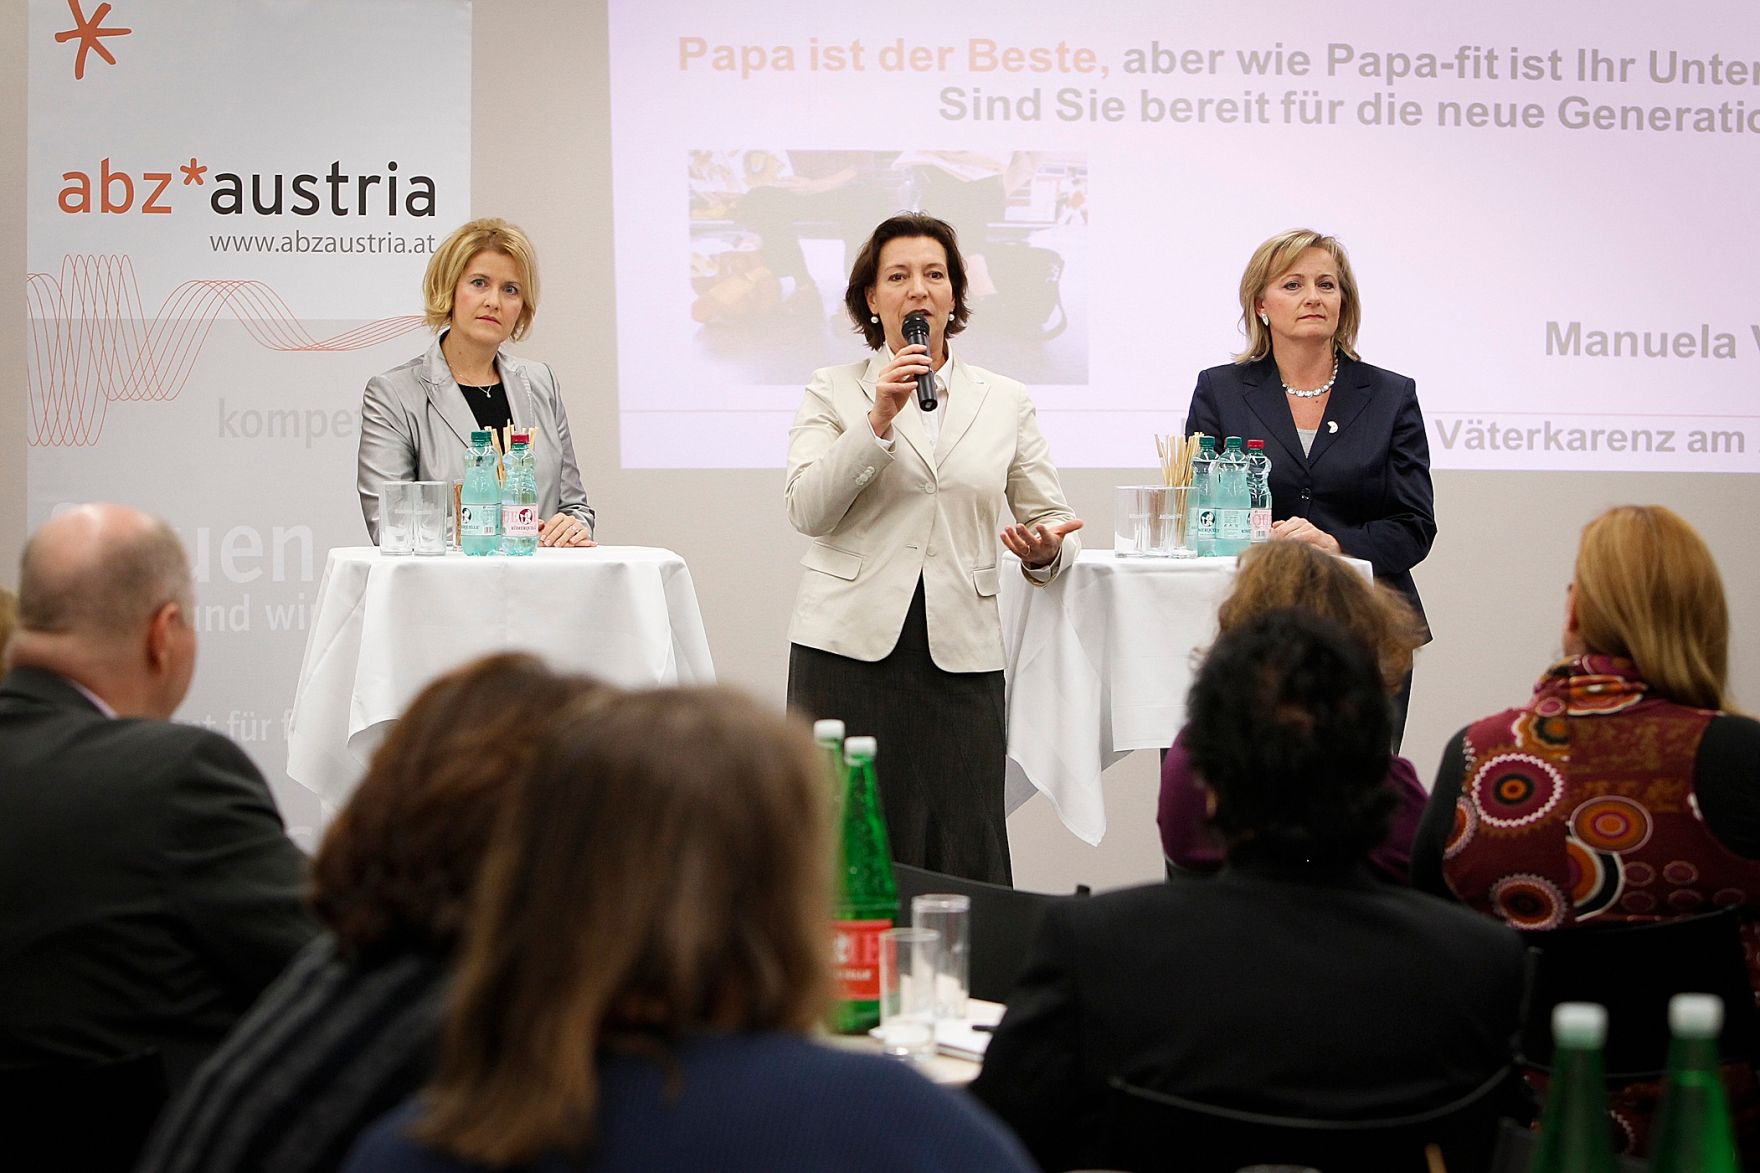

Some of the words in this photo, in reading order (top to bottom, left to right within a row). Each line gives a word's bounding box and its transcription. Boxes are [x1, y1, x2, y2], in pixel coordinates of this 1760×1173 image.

[679, 36, 796, 80] Papa
[809, 37, 865, 72] ist
[878, 38, 955, 73] der
[968, 38, 1110, 79] Beste,
[1123, 41, 1224, 75] aber
[1236, 42, 1311, 76] wie
[1327, 43, 1499, 86] Papa-fit
[1510, 46, 1563, 81] ist
[1577, 49, 1637, 83] Ihr
[939, 87, 1042, 122] Sind
[1055, 88, 1126, 122] Sie
[1140, 89, 1270, 124] bereit
[1281, 91, 1345, 125] für
[1356, 93, 1423, 127] die
[1437, 101, 1545, 129] neue
[210, 230, 436, 255] www.abzaustria.at
[1545, 321, 1737, 359] Manuela
[218, 397, 357, 449] kompe
[1435, 419, 1676, 453] Väterkarenz
[1687, 430, 1745, 454] am
[226, 709, 272, 741] für
